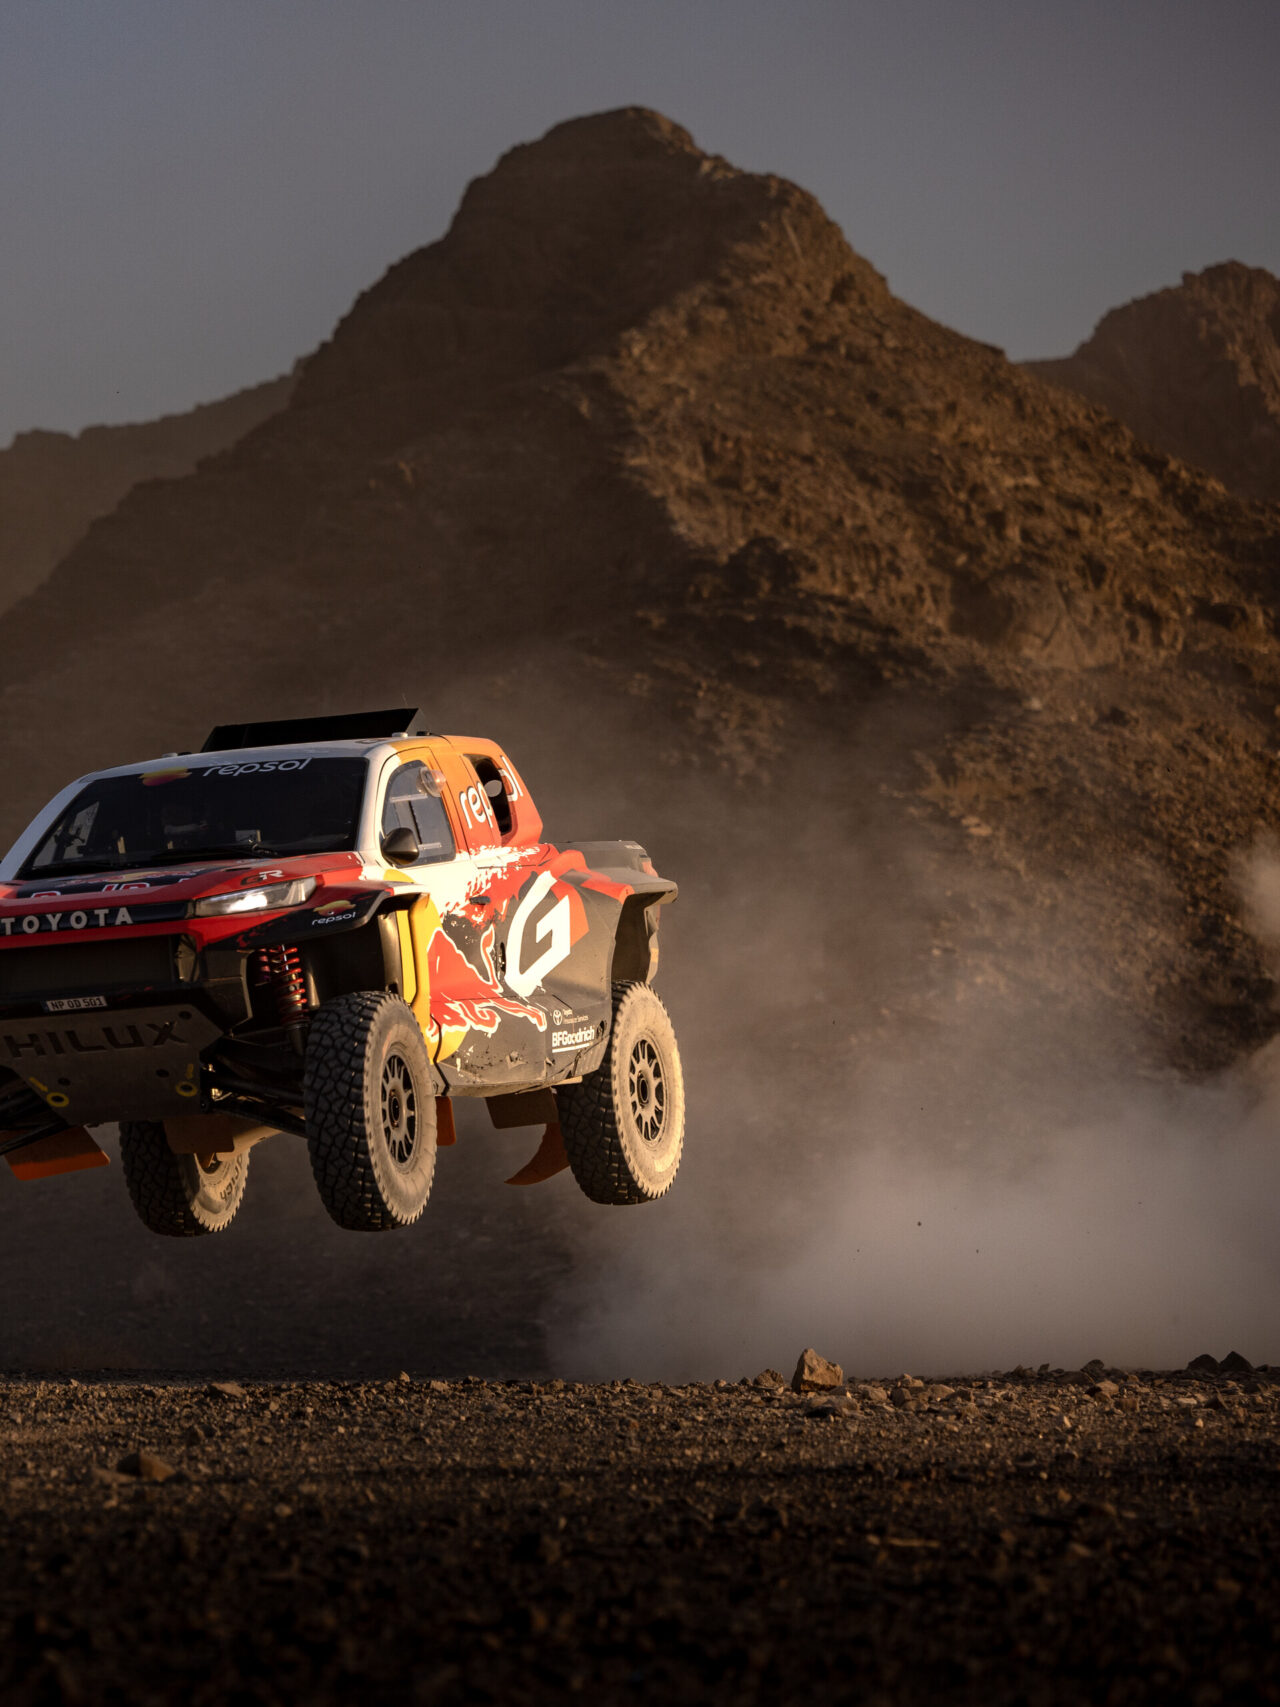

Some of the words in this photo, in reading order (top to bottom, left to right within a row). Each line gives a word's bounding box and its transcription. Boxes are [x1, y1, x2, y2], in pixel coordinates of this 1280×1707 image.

[202, 757, 313, 777] repsol
[460, 754, 524, 829] repol
[0, 907, 134, 936] TOYOTA
[311, 912, 357, 925] repsol
[51, 1000, 64, 1010] NP
[3, 1020, 190, 1058] HILUX
[552, 1026, 595, 1047] BFGoodrich
